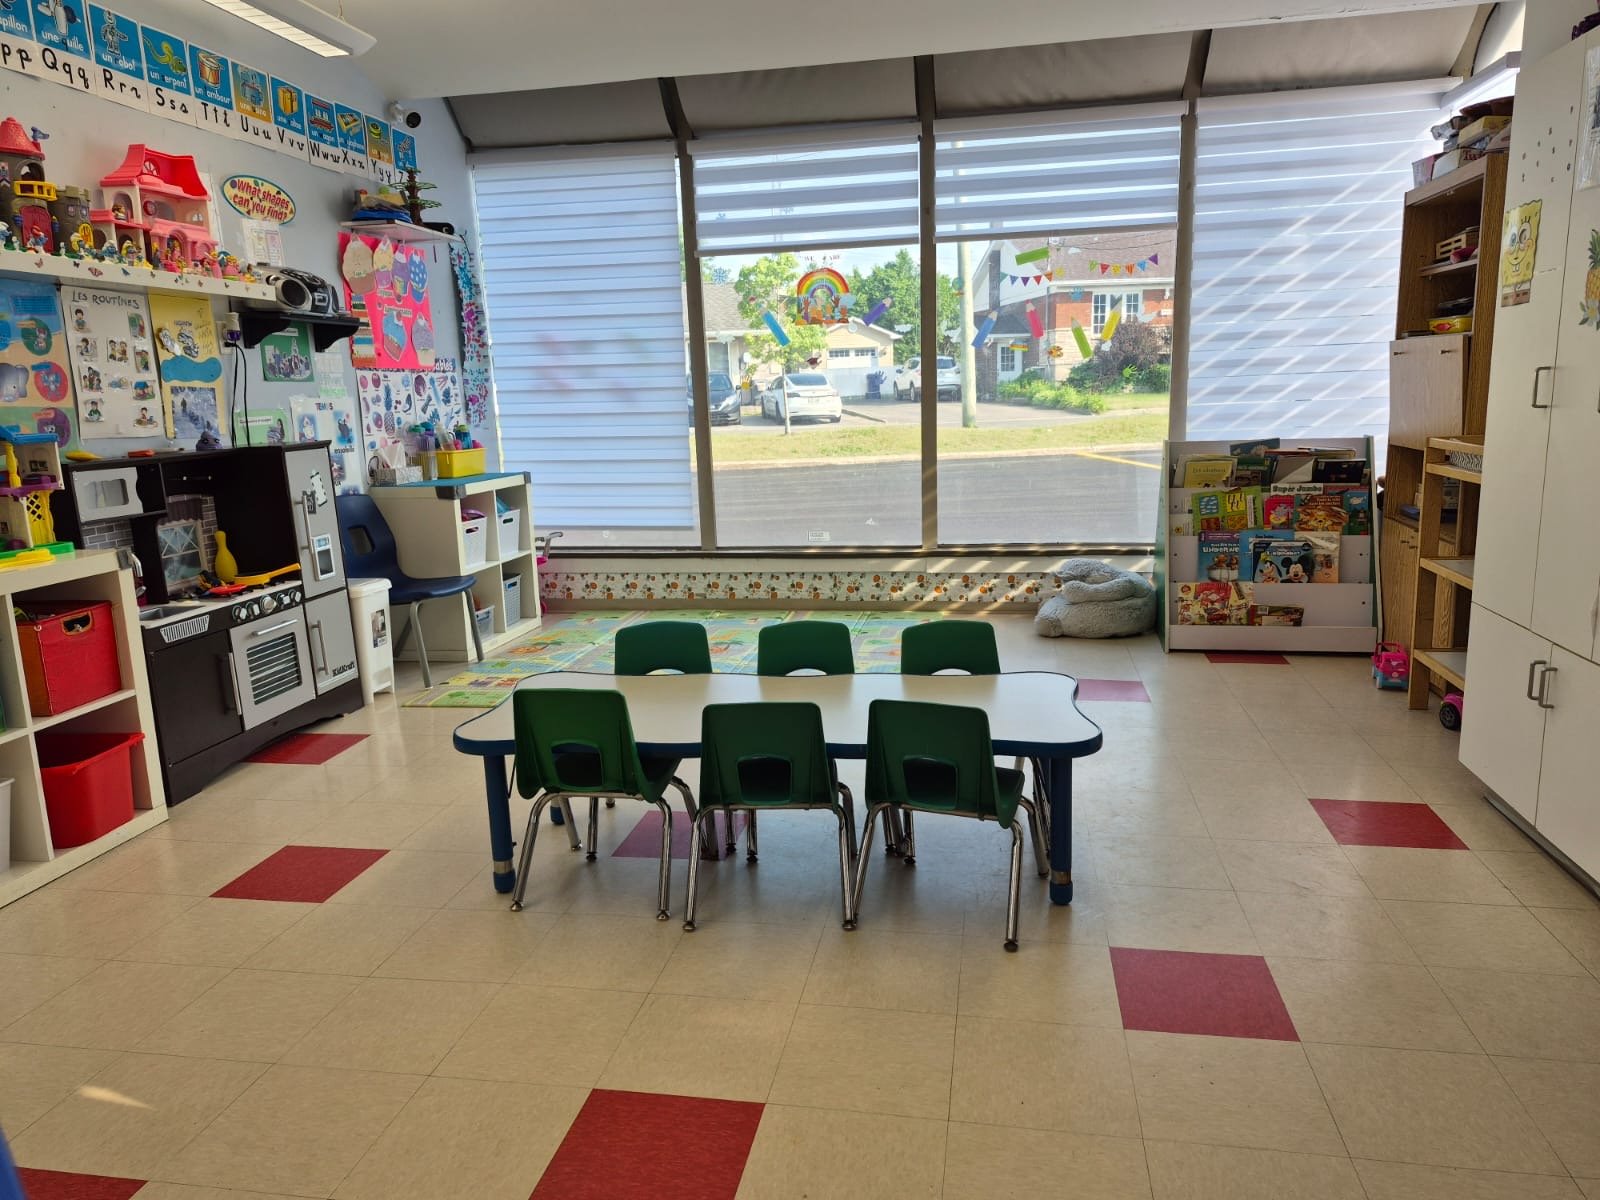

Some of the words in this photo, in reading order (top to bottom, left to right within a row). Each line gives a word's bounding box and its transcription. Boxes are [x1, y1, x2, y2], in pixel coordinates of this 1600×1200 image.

[41, 30, 60, 43] une
[62, 35, 84, 51] quille
[102, 53, 112, 63] un
[114, 55, 135, 71] robot
[150, 71, 159, 79] un
[195, 87, 204, 95] un
[237, 178, 261, 198] What
[262, 190, 290, 211] shapes
[233, 194, 250, 208] can
[252, 201, 266, 215] you
[266, 205, 288, 220] find?
[72, 290, 88, 303] LES
[92, 294, 139, 310] ROUTINES
[315, 402, 334, 411] TEMS
[332, 660, 355, 677] KidKraft
